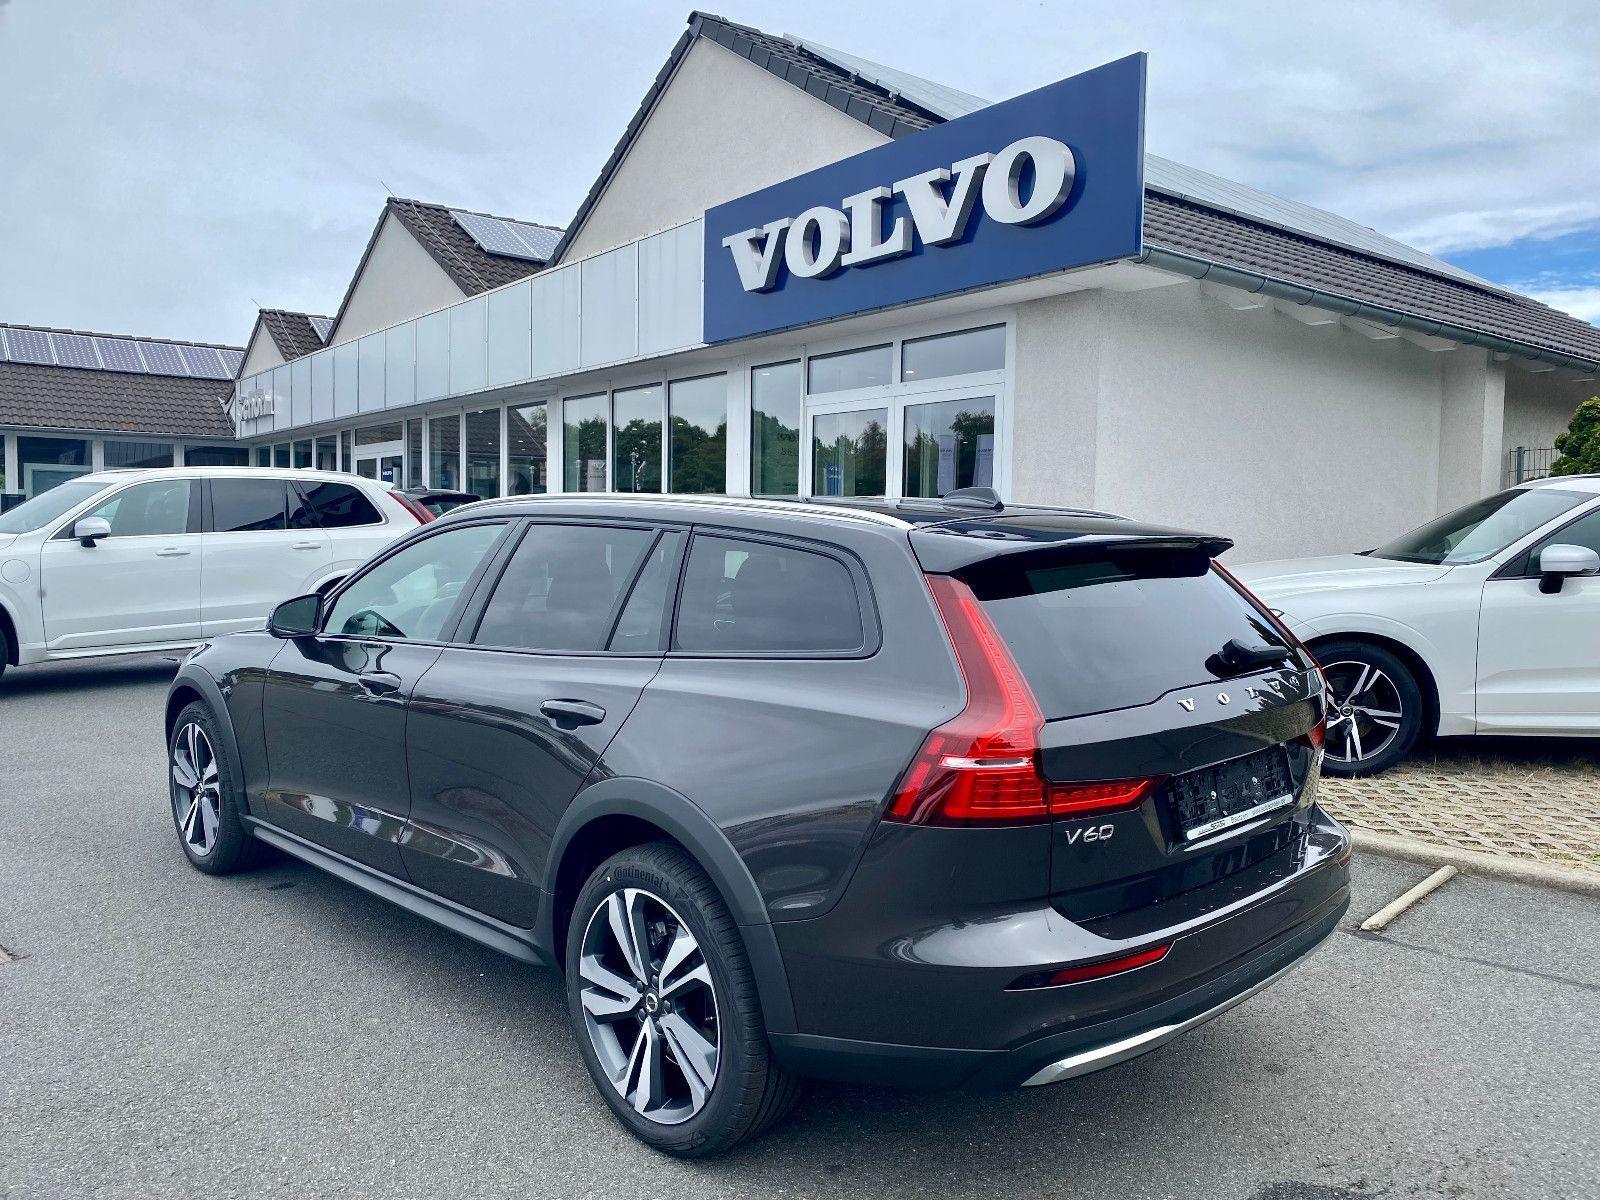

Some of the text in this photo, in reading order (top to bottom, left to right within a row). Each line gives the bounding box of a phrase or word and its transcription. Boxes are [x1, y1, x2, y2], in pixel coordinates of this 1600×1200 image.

[722, 135, 1076, 292] VOLVO
[1177, 676, 1301, 712] VOLVO
[1065, 824, 1114, 844] V60
[613, 865, 665, 890] Continental
